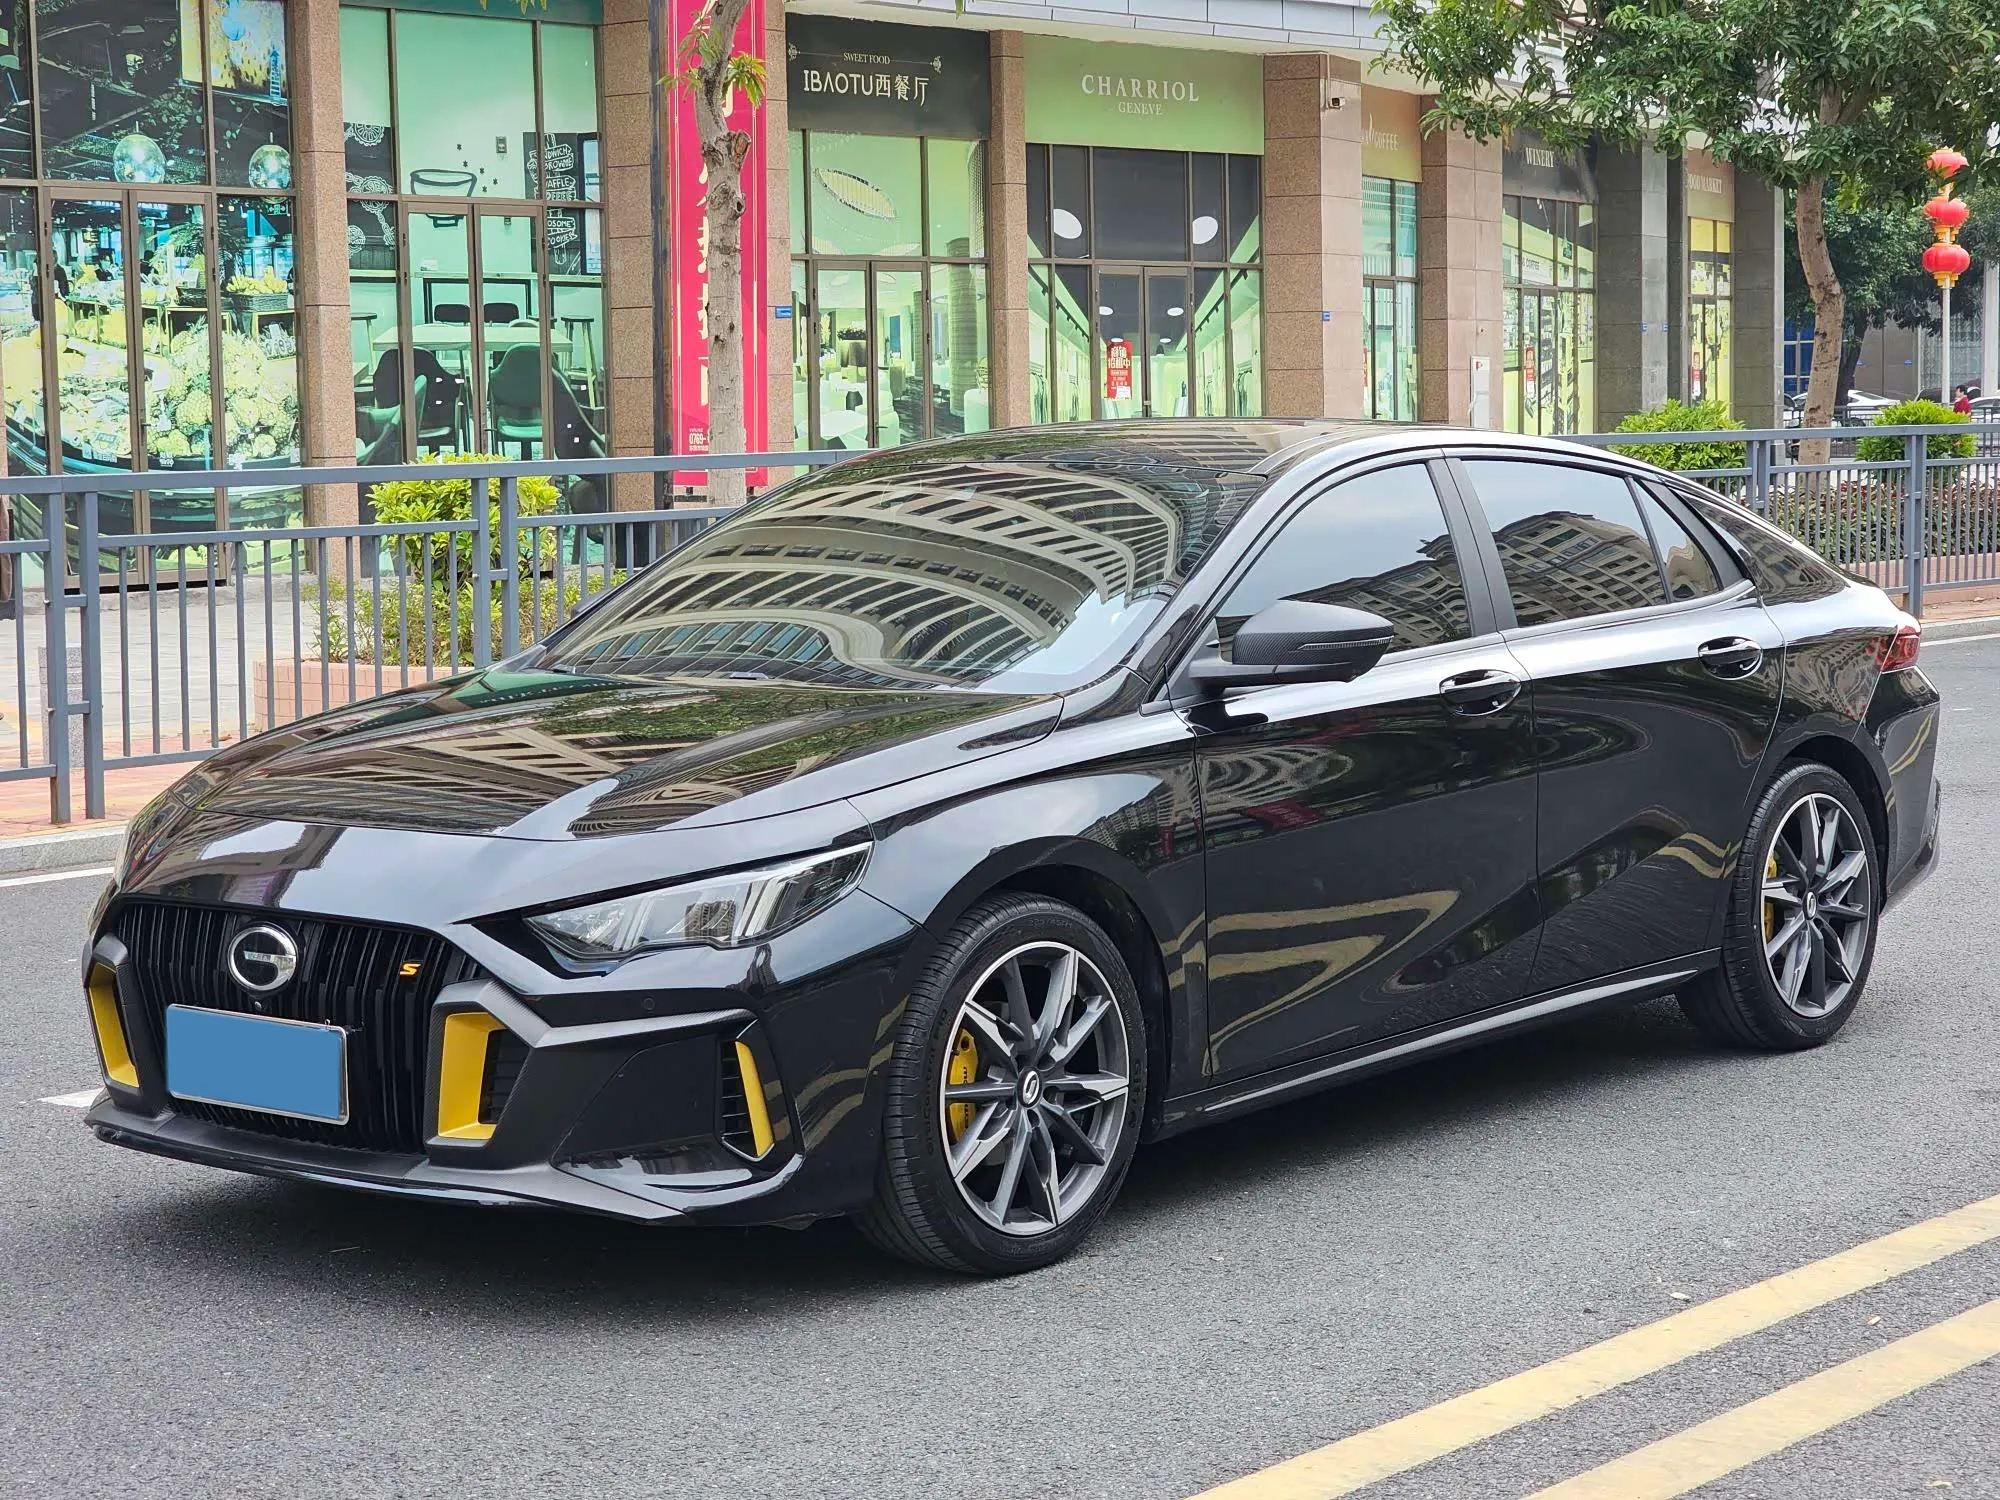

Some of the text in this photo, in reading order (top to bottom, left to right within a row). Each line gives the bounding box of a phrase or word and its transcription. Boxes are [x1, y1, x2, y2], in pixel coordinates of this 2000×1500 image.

[843, 52, 890, 65] SWEET FOOD
[1081, 74, 1199, 102] CHARRIOL
[1118, 101, 1163, 115] GENEVE
[1525, 147, 1554, 168] WINERY
[1701, 175, 1722, 194] MARKET
[400, 963, 422, 976] S
